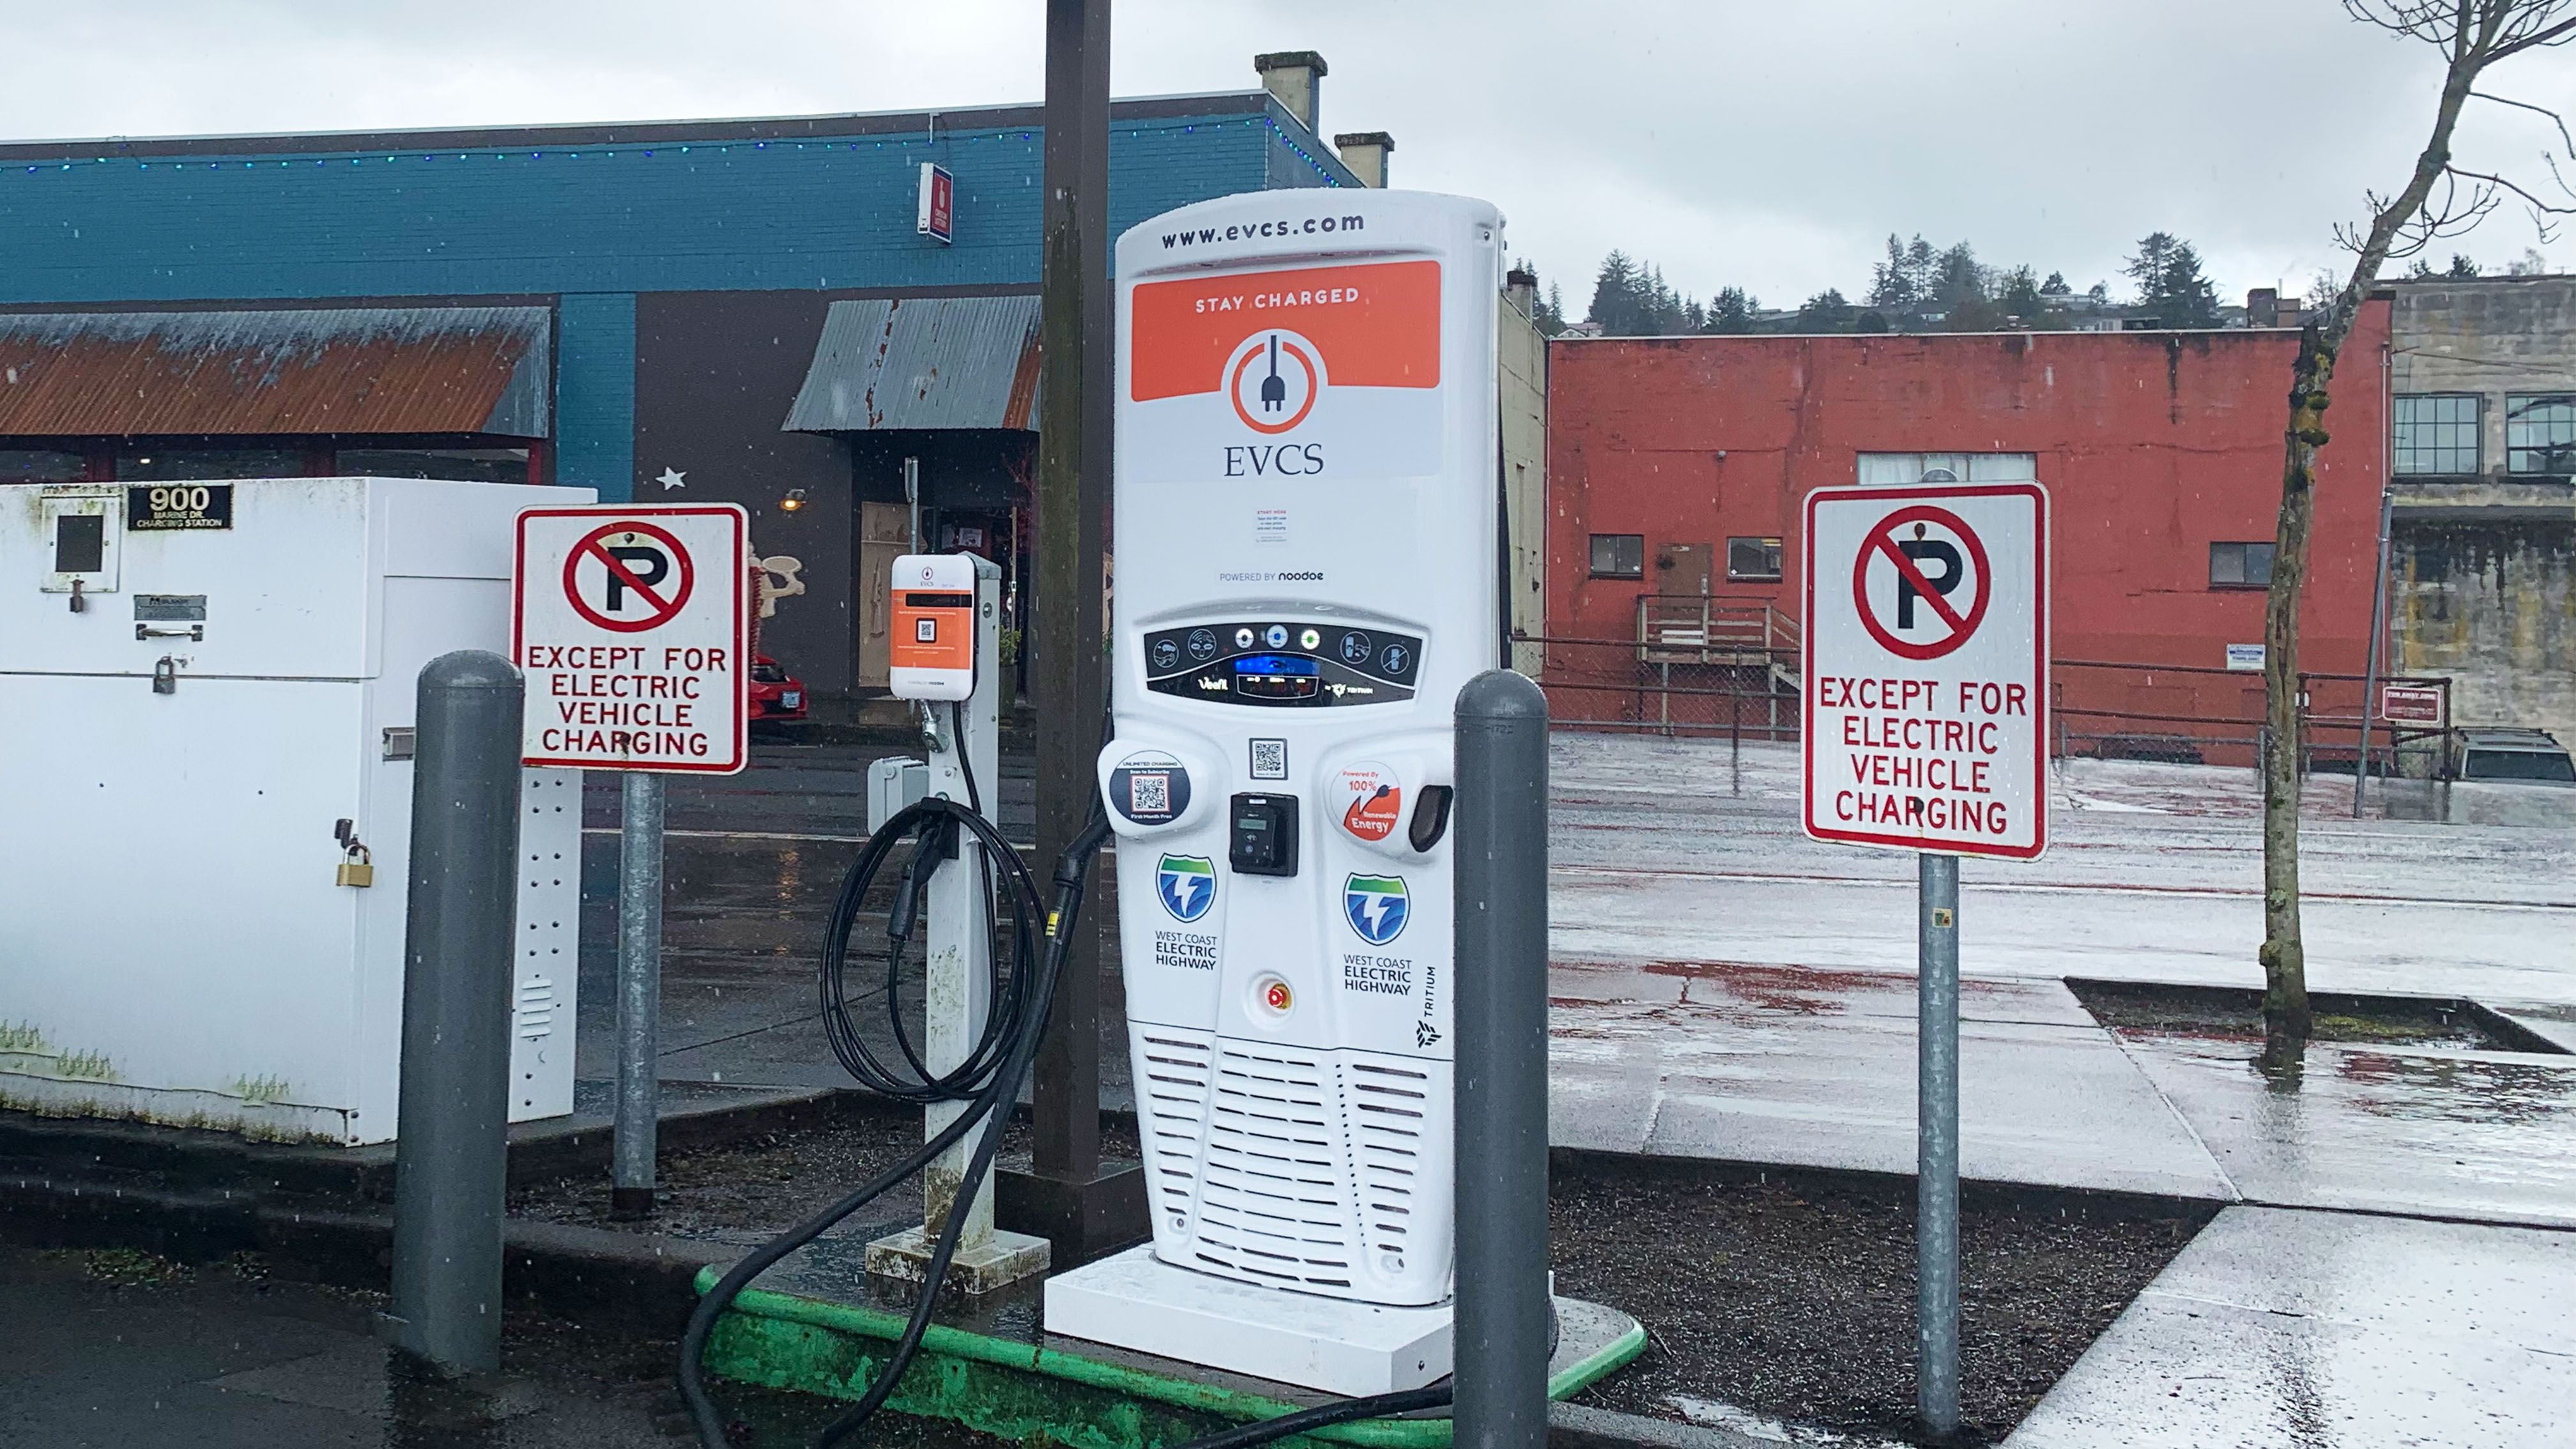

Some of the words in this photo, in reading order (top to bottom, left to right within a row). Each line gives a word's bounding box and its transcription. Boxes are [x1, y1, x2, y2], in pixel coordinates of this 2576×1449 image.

[1162, 215, 1364, 249] www.evcs.com
[1195, 296, 1245, 313] STAY
[1255, 288, 1359, 309] CHARGED
[1223, 443, 1324, 477] EVCS
[150, 487, 210, 511] 900
[1220, 572, 1262, 581] POWERED
[1278, 571, 1324, 581] noodoe
[529, 646, 645, 670] EXCEPT
[665, 648, 726, 671] FOR
[552, 673, 700, 700] ELECTRIC
[1821, 677, 1938, 710] EXCEPT
[1961, 682, 2027, 716] FOR
[558, 702, 693, 727] VEHICLE
[543, 728, 708, 756] CHARGING
[1844, 716, 1999, 755] ELECTRIC
[1851, 753, 1991, 793] VEHICLE
[1349, 780, 1377, 792] 100%
[1836, 790, 2007, 834] CHARGING
[1351, 817, 1389, 833] Energy
[1155, 930, 1182, 942] WEST
[1184, 934, 1217, 946] COAST
[1156, 942, 1216, 958] ELECTRIC
[1156, 954, 1216, 970] HIGHWAY
[1344, 954, 1374, 967] WEST
[1376, 957, 1412, 970] COAST
[1344, 966, 1411, 983] ELECTRIC
[1345, 979, 1411, 995] HIGHWAY
[1424, 966, 1436, 1017] TRITIUM
